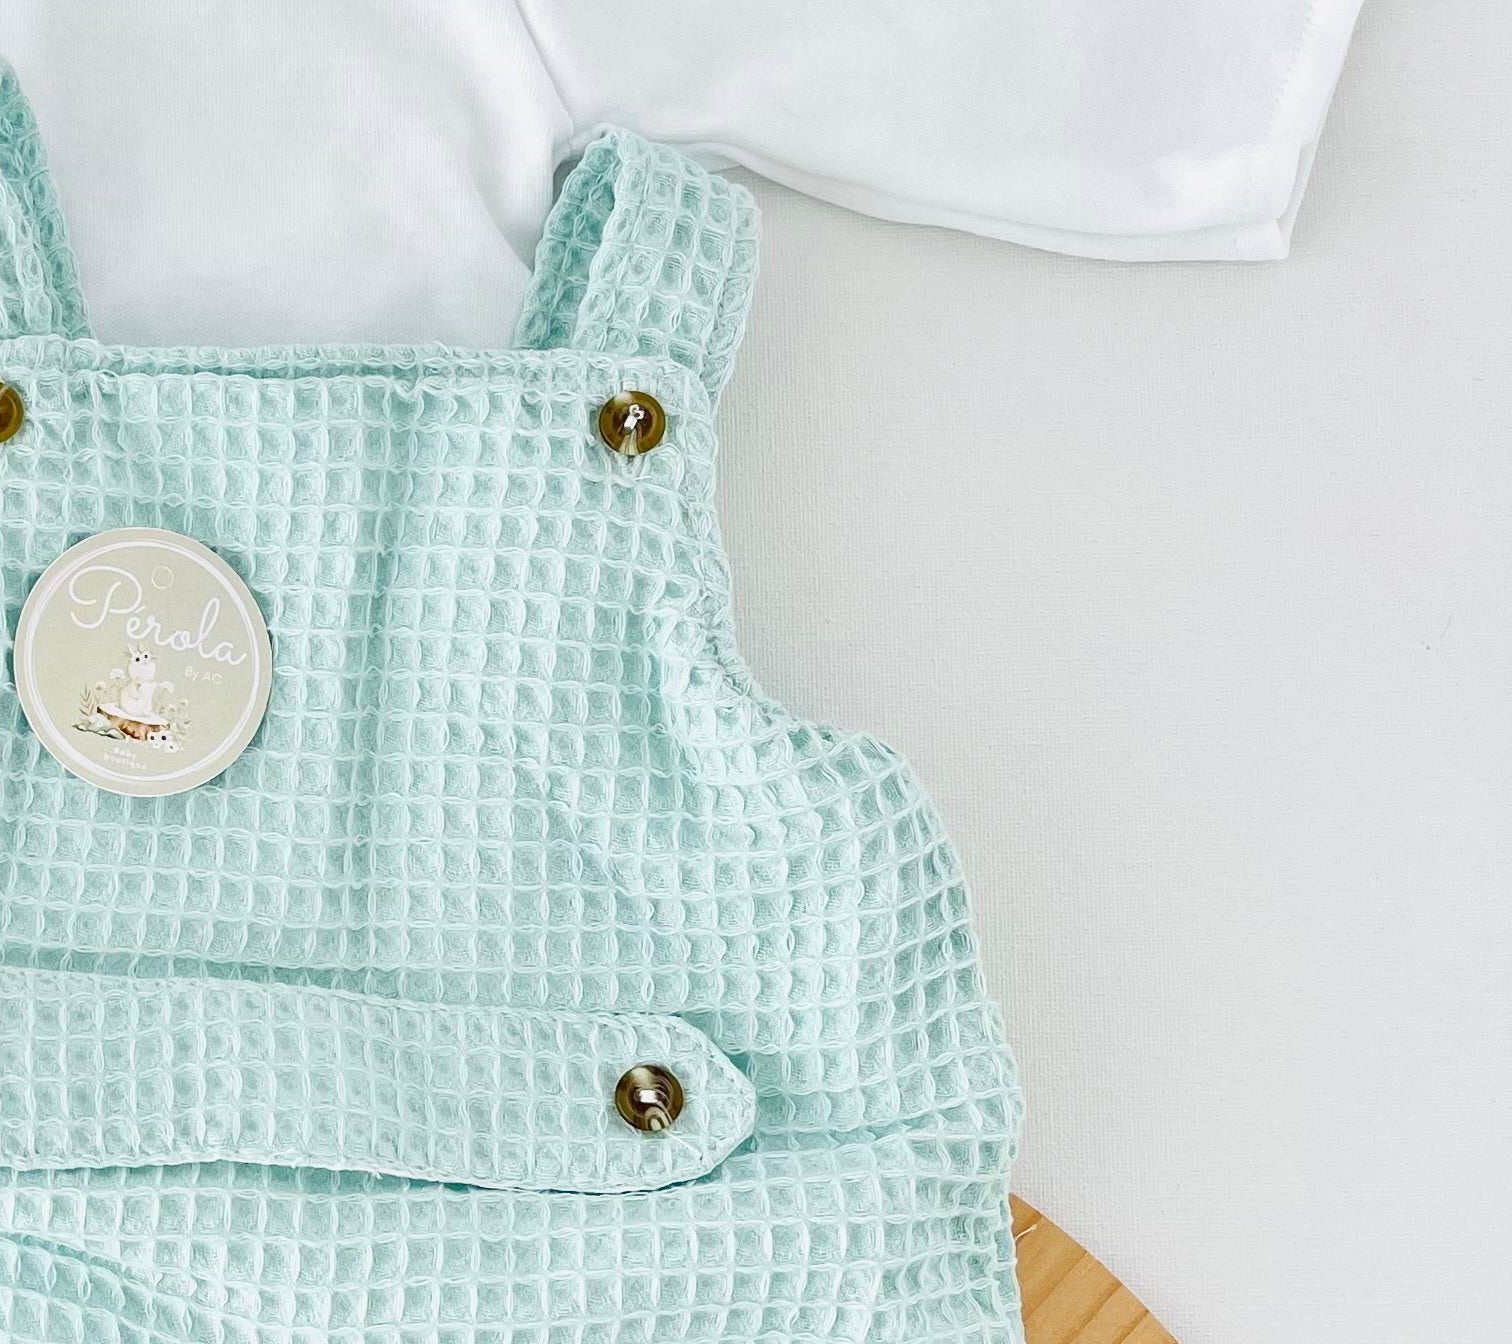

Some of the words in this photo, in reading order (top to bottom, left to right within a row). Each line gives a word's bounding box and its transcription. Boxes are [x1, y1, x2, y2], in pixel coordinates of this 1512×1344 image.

[68, 564, 248, 666] Pérola
[184, 664, 200, 682] By
[201, 671, 223, 685] AC
